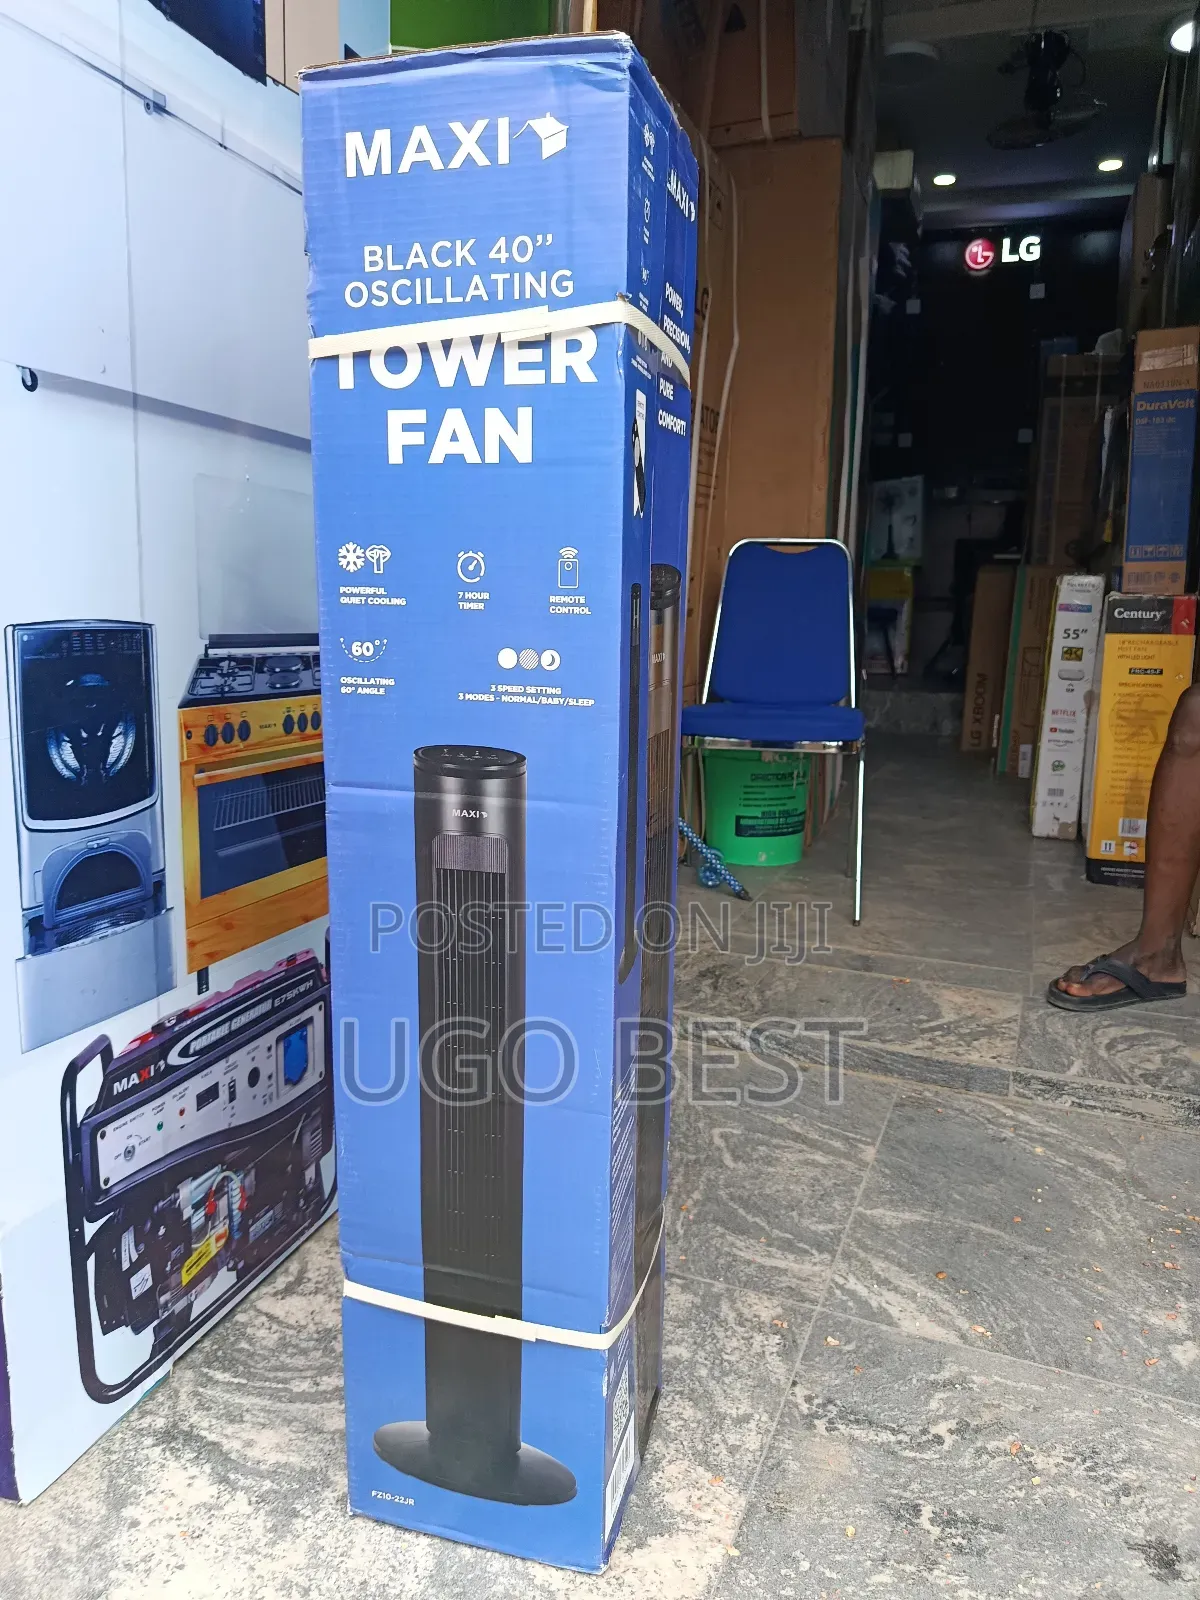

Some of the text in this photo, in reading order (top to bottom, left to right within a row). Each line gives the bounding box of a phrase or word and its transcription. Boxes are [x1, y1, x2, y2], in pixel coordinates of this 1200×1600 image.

[345, 116, 510, 178] MAXI
[363, 238, 477, 273] BLACK
[1001, 235, 1041, 263] LG
[344, 269, 574, 308] OSCILLATING
[665, 281, 684, 319] POWER,
[663, 314, 691, 354] PRECISION,
[659, 377, 674, 401] PURE
[1136, 398, 1195, 412] DuraVolt
[658, 409, 687, 437] COMFORT!
[387, 406, 534, 465] FAN
[339, 586, 388, 595] POWERFUL
[458, 591, 490, 600] 7 HOUR
[340, 596, 407, 606] QUIET COOLING
[458, 601, 485, 610] TIMER
[549, 595, 586, 604] REMOTE
[549, 605, 592, 615] CONTROL
[1113, 607, 1162, 622] Century
[351, 638, 381, 657] 60°
[340, 676, 395, 686] OSCILLATING
[357, 686, 386, 695] ANGLE
[490, 684, 562, 695] 3 SPEED SETTING
[458, 692, 464, 700] 3
[465, 693, 495, 701] MODES
[501, 694, 595, 707] NORMAL/BABY/SLEEP
[1051, 709, 1077, 717] NETFLIX
[969, 730, 982, 747] LG
[452, 808, 480, 819] MAXI
[189, 1021, 231, 1055] PORTABLE
[231, 998, 273, 1032] GENERATOR
[113, 1064, 155, 1096] MAXI
[371, 1489, 415, 1506] FZ10-22JR
